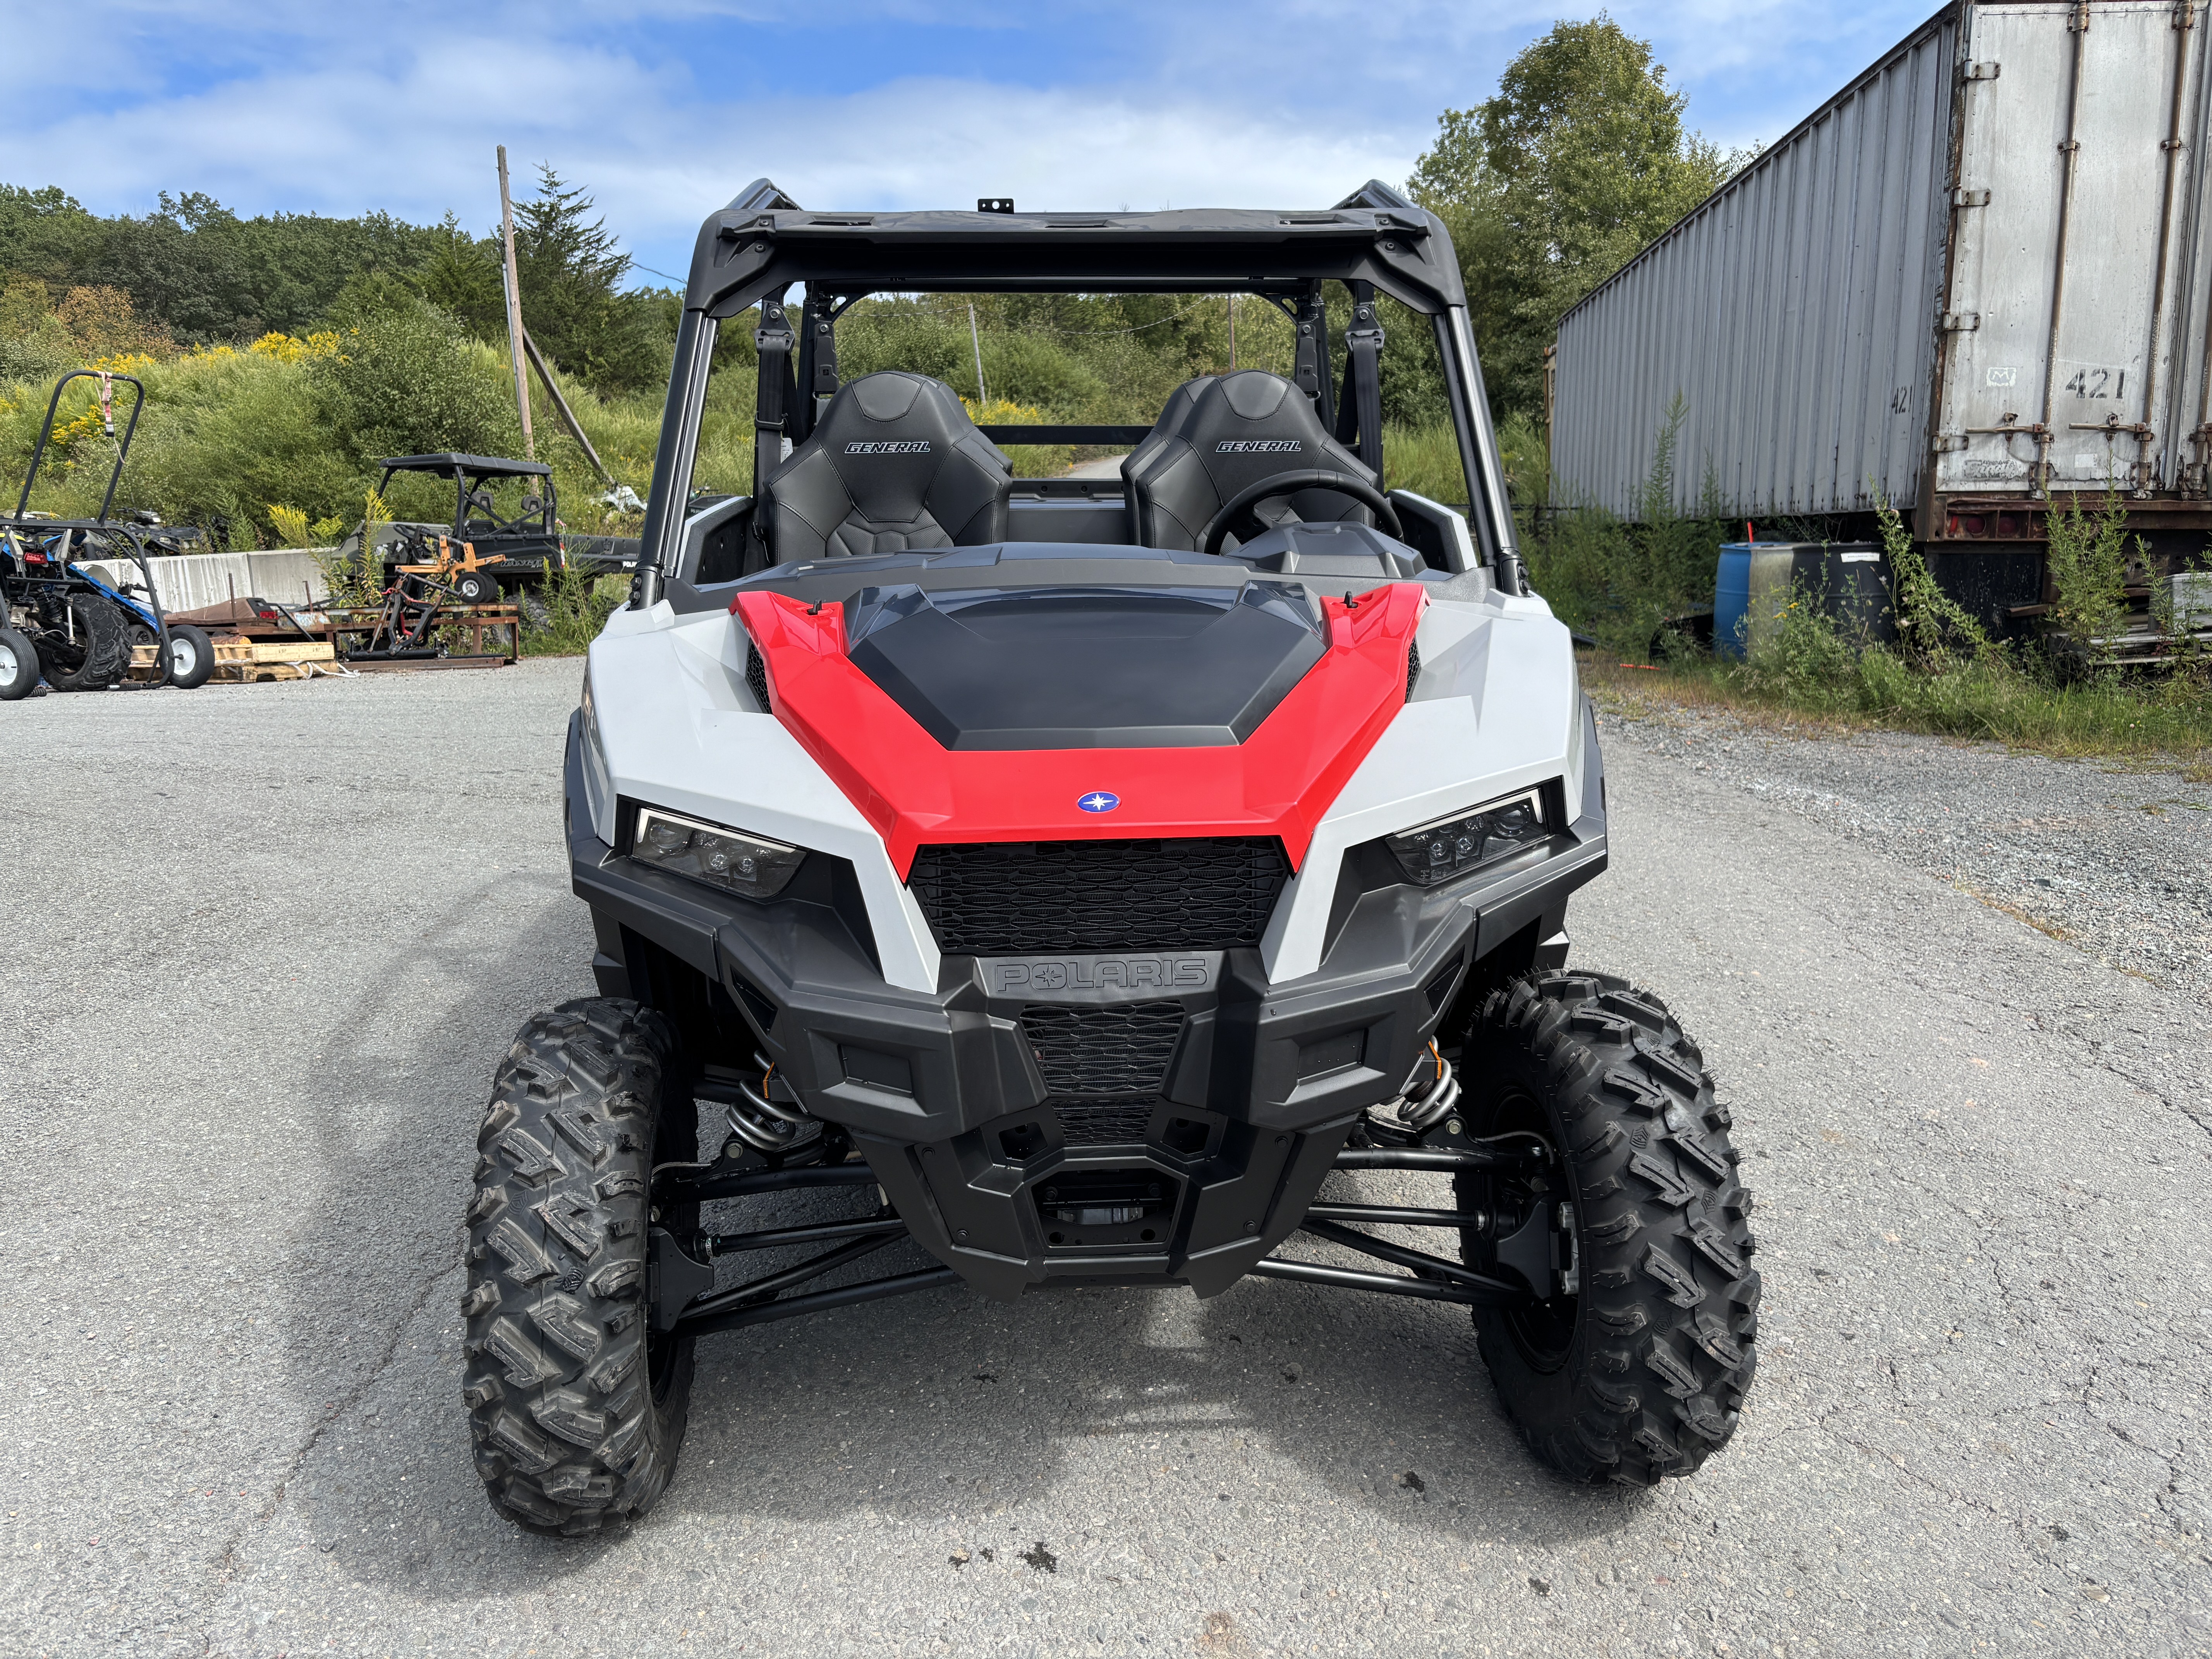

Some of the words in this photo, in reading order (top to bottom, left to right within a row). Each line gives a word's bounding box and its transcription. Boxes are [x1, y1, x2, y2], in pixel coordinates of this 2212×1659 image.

[2065, 369, 2125, 399] 421
[1891, 385, 1912, 414] 421
[844, 441, 931, 454] GENERAL
[1215, 441, 1302, 453] GENERAL
[996, 958, 1207, 991] POLARIS
